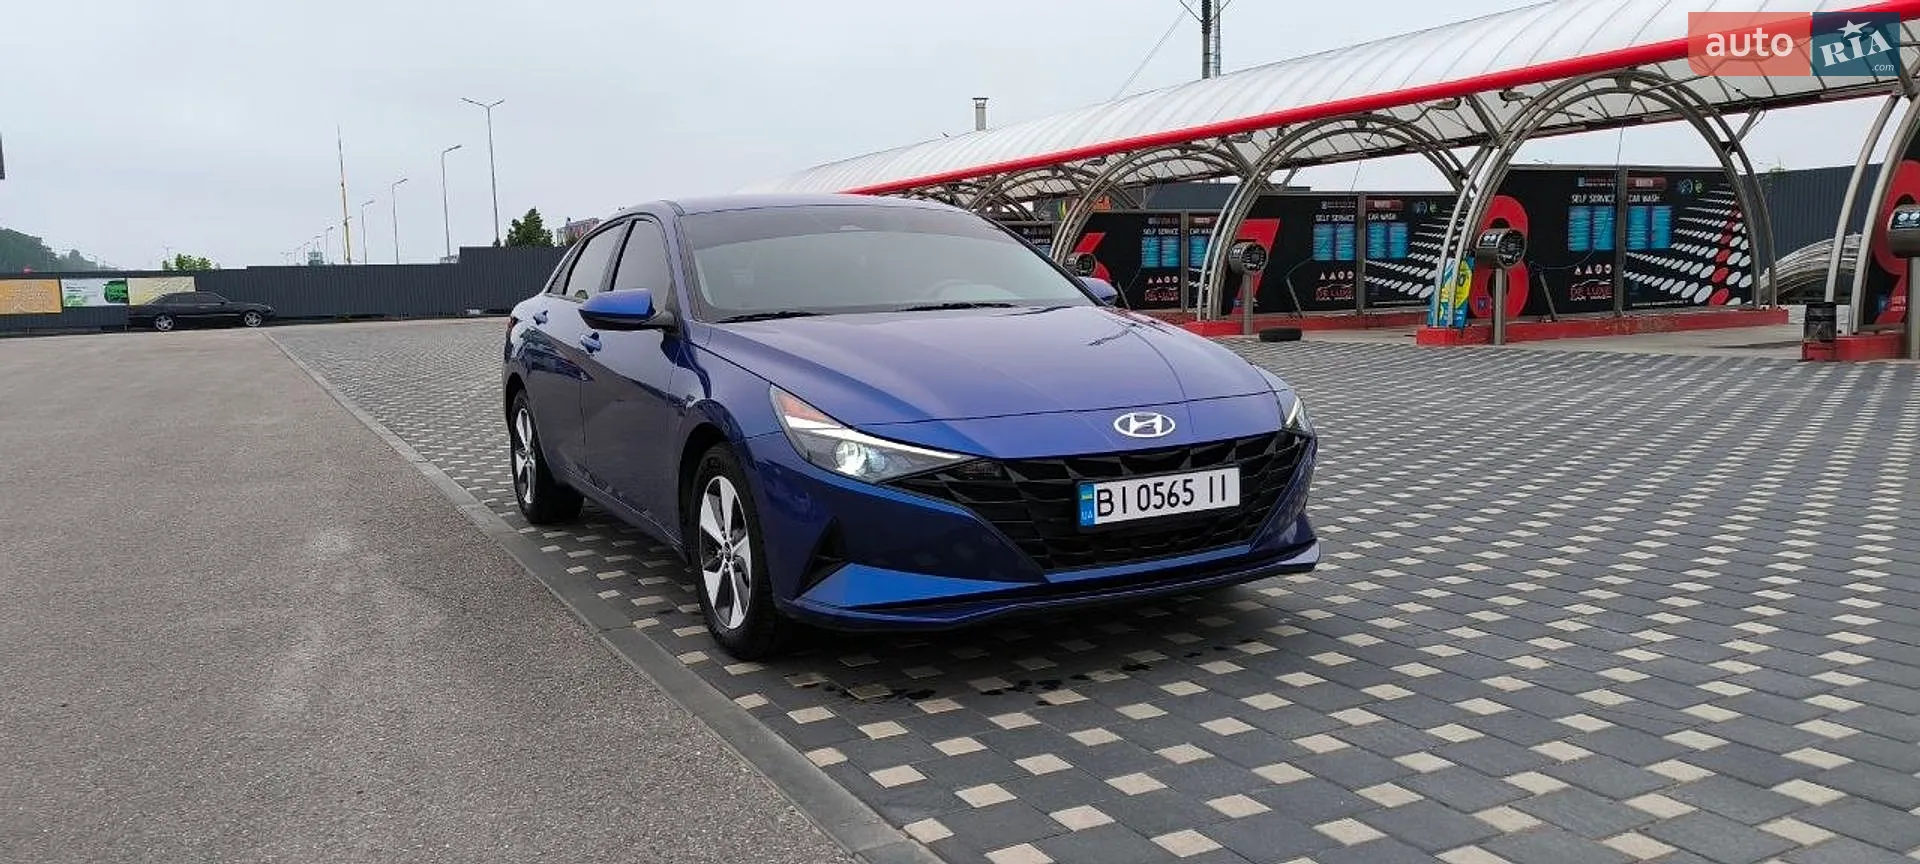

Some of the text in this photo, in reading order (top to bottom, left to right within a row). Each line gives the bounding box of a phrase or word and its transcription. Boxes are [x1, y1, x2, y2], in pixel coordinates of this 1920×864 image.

[1571, 194, 1660, 203] SELF SERVICE CAR WASH
[1315, 214, 1330, 222] SELF
[1469, 195, 1529, 318] 8
[1096, 474, 1226, 517] BI 0565 II
[1081, 509, 1094, 521] UA
